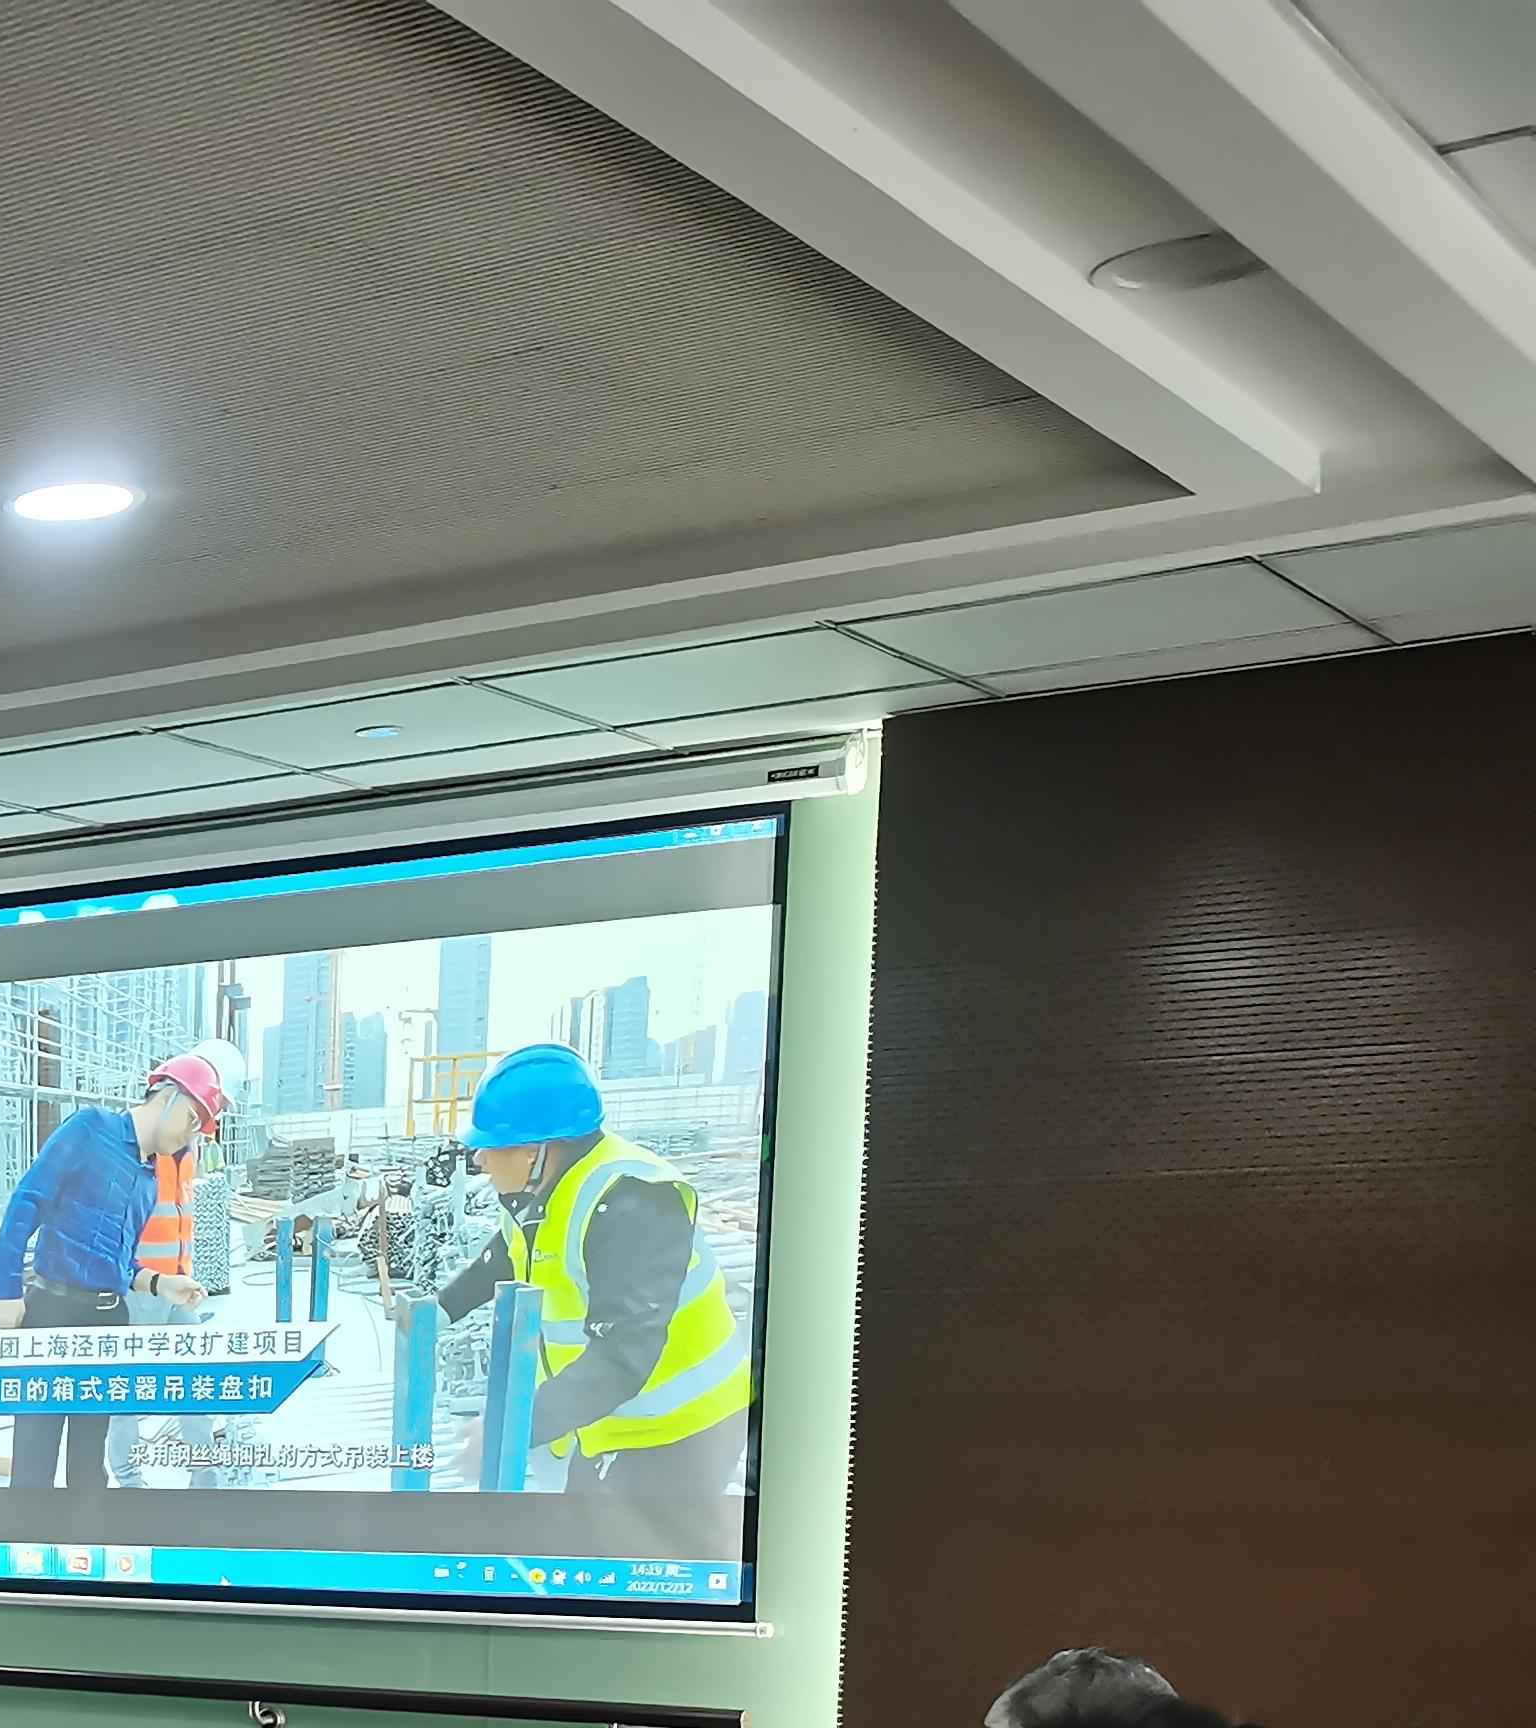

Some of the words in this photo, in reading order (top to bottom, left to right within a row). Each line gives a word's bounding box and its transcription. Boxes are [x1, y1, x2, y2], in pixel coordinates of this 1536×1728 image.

[127, 1442, 436, 1469] 采用钢丝绳捆扎的方式吊装上楼
